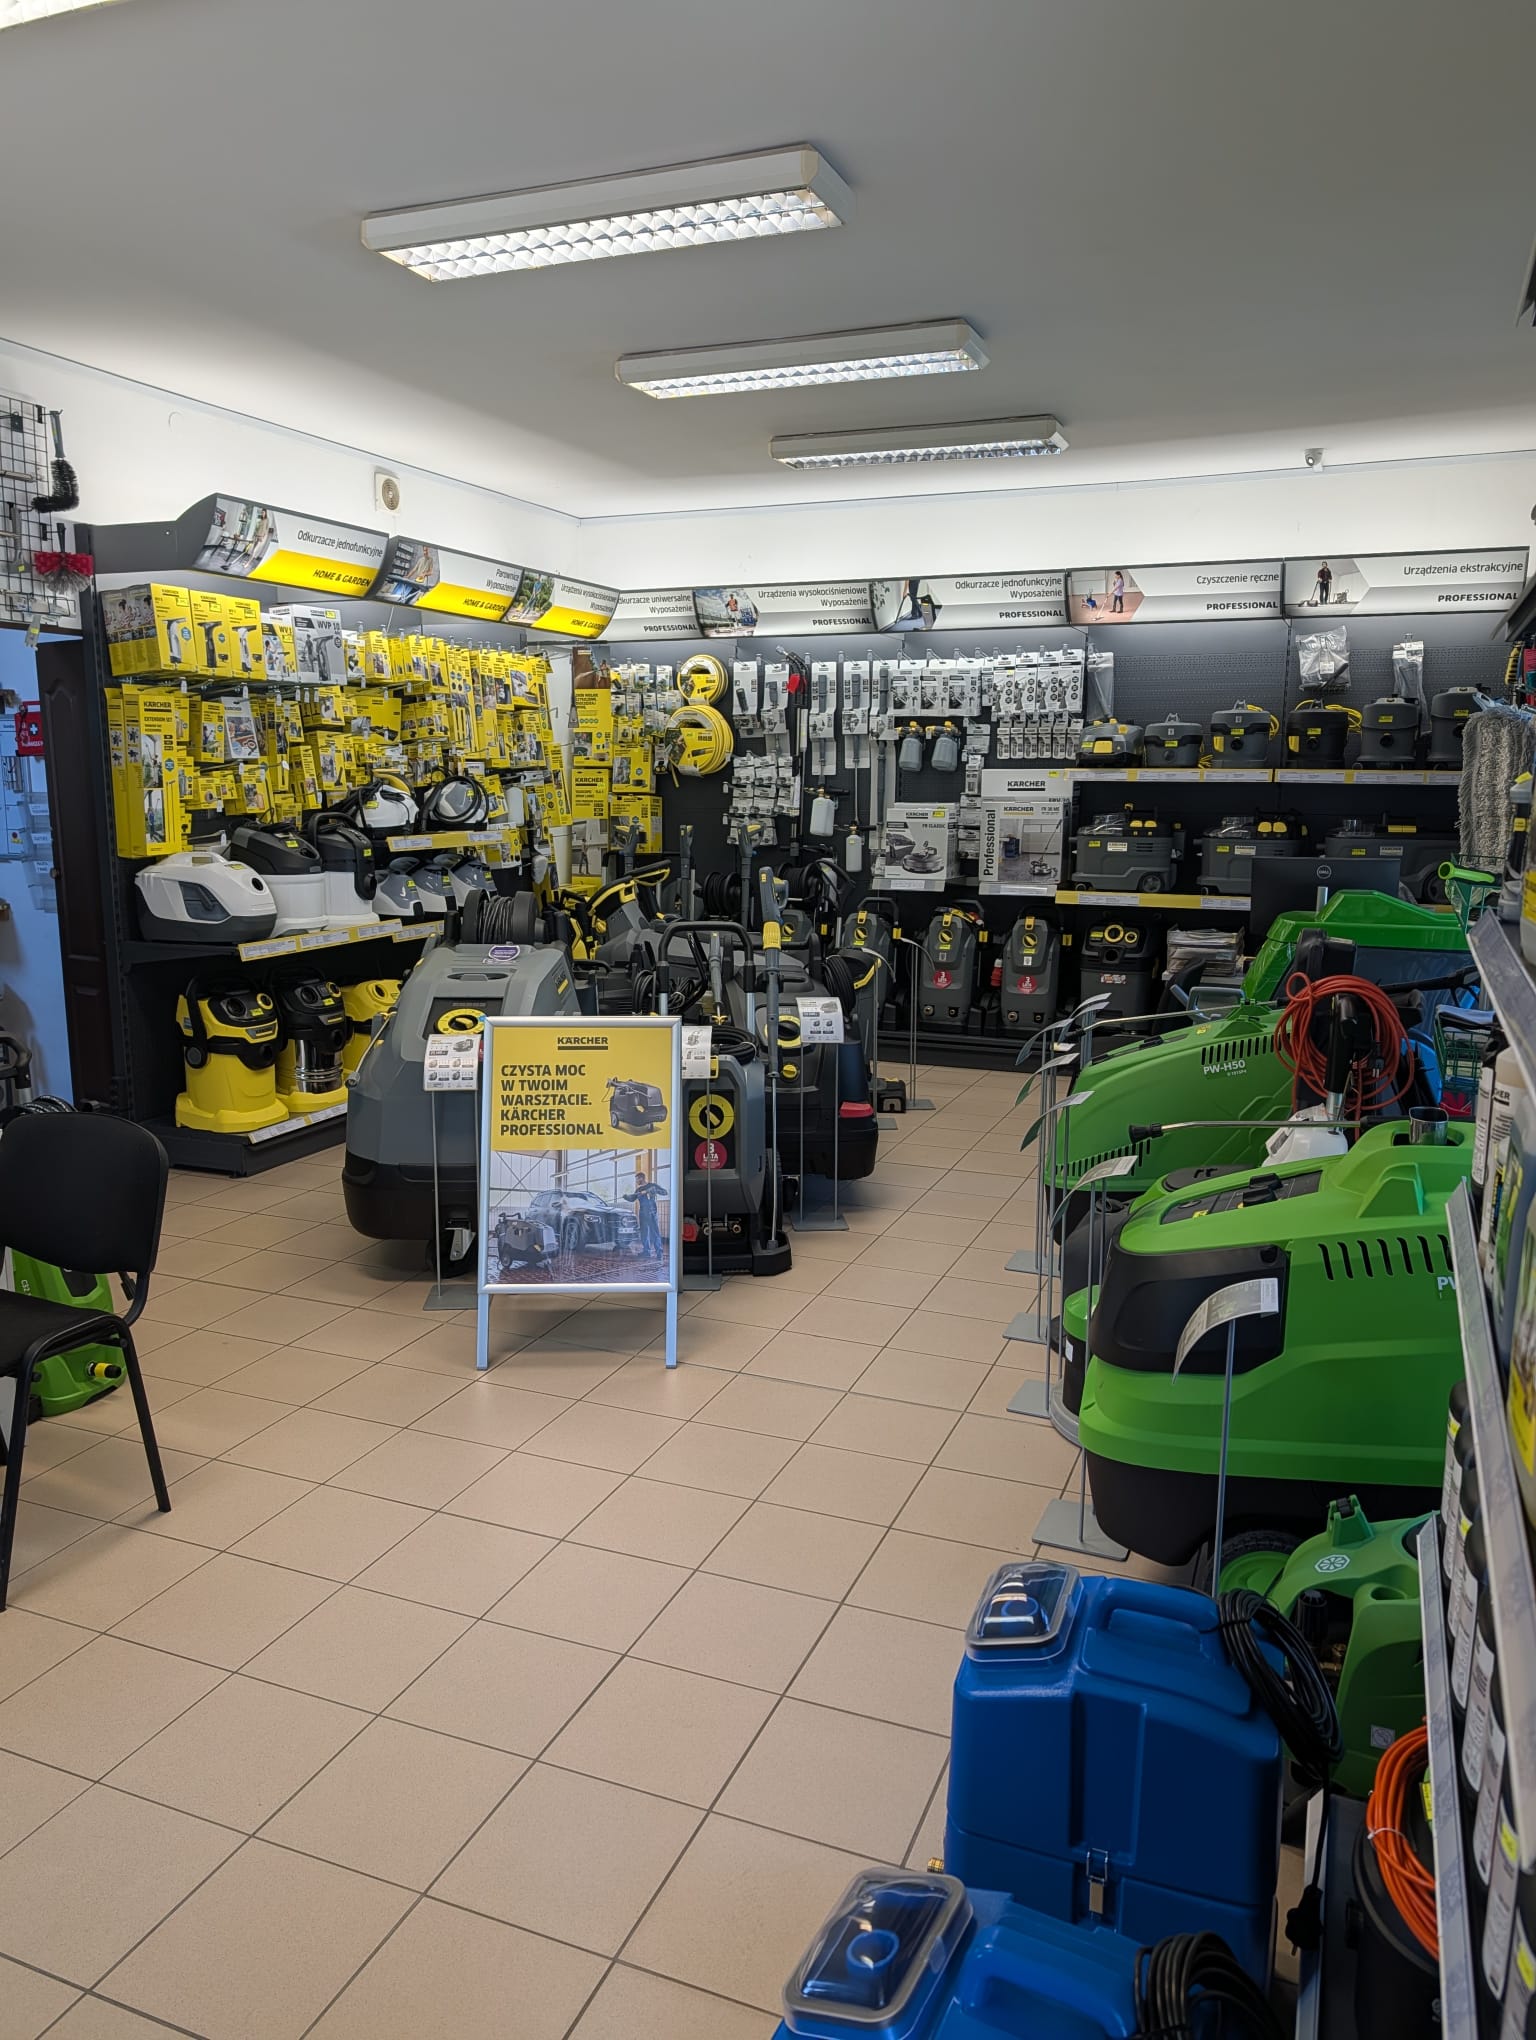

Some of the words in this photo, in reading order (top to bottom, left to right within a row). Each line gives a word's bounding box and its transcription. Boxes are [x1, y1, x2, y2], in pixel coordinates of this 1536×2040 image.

[298, 530, 335, 547] Odkurzacze
[335, 538, 383, 557] jednofunkcyjne
[1404, 564, 1457, 576] Urządzenia
[1460, 562, 1524, 573] ekstrakcyjne
[313, 569, 335, 580] HOME
[342, 575, 372, 587] GARDEN
[956, 580, 1000, 590] Odkurzacze
[1002, 577, 1062, 588] jednofunkcyjne
[1196, 574, 1248, 585] Czyszczenie
[1250, 574, 1280, 583] ręczne
[758, 589, 797, 599] Urządzenia
[799, 586, 867, 598] wysokociśnieniowe
[1010, 589, 1062, 599] Wyposażenie
[1438, 593, 1519, 602] PROFESSIONAL
[652, 594, 691, 603] uniwersalne
[820, 597, 868, 608] Wyposażenie
[463, 598, 481, 607] HOME
[484, 602, 506, 612] GARDEN
[649, 606, 693, 615] Wyposażenie
[1206, 602, 1279, 610] PROFESSIONAL
[1000, 610, 1064, 619] PROFESSIONAL
[317, 620, 332, 629] WVP
[571, 618, 584, 627] HOME
[812, 618, 872, 626] PROFESSIONAL
[644, 624, 697, 632] PROFESSIONAL
[983, 810, 996, 876] Professional
[557, 1036, 608, 1045] KÄRCHER
[501, 1064, 551, 1076] CZYSTA
[555, 1064, 586, 1076] MOC
[1204, 1060, 1246, 1075] PW-H50
[501, 1080, 514, 1091] W
[518, 1080, 568, 1091] TWOIM
[501, 1094, 592, 1106] WARSZTACIE.
[500, 1106, 565, 1121] KÄRCHER
[500, 1124, 604, 1136] PROFESSIONAL
[708, 1142, 715, 1153] 3
